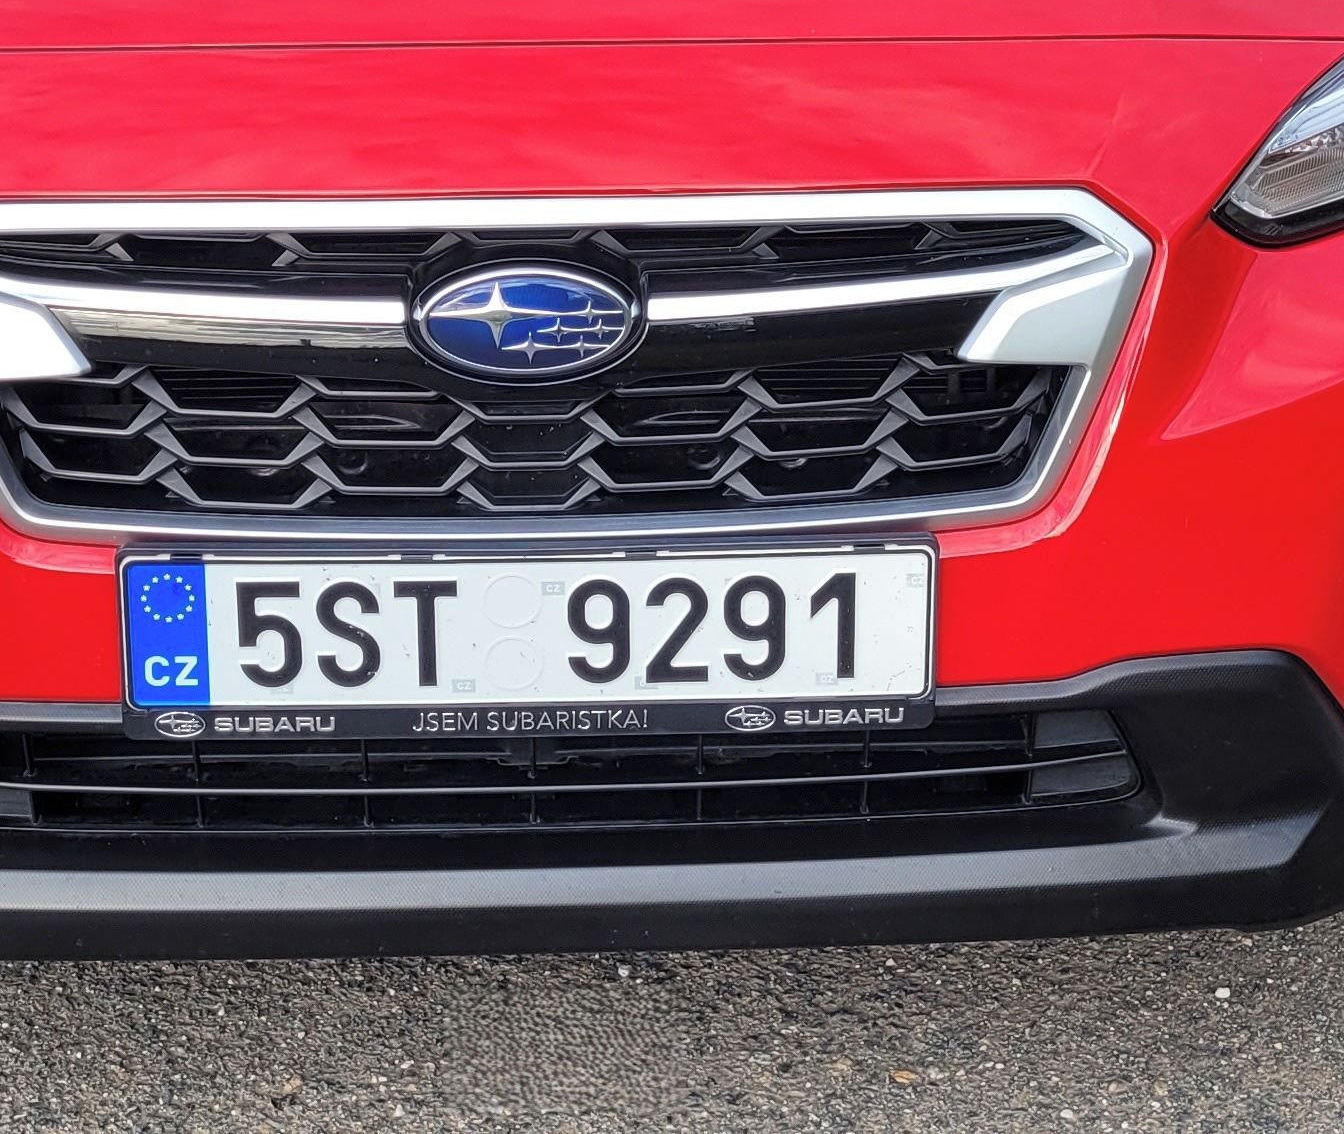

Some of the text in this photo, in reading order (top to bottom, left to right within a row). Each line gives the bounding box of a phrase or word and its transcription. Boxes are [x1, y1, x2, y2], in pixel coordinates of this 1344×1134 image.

[235, 572, 857, 687] 5ST 9291
[144, 655, 199, 687] CZ
[214, 716, 336, 733] SUBARU
[412, 709, 649, 732] JSEM SUBARISTKA!
[783, 707, 905, 726] SUBARU
